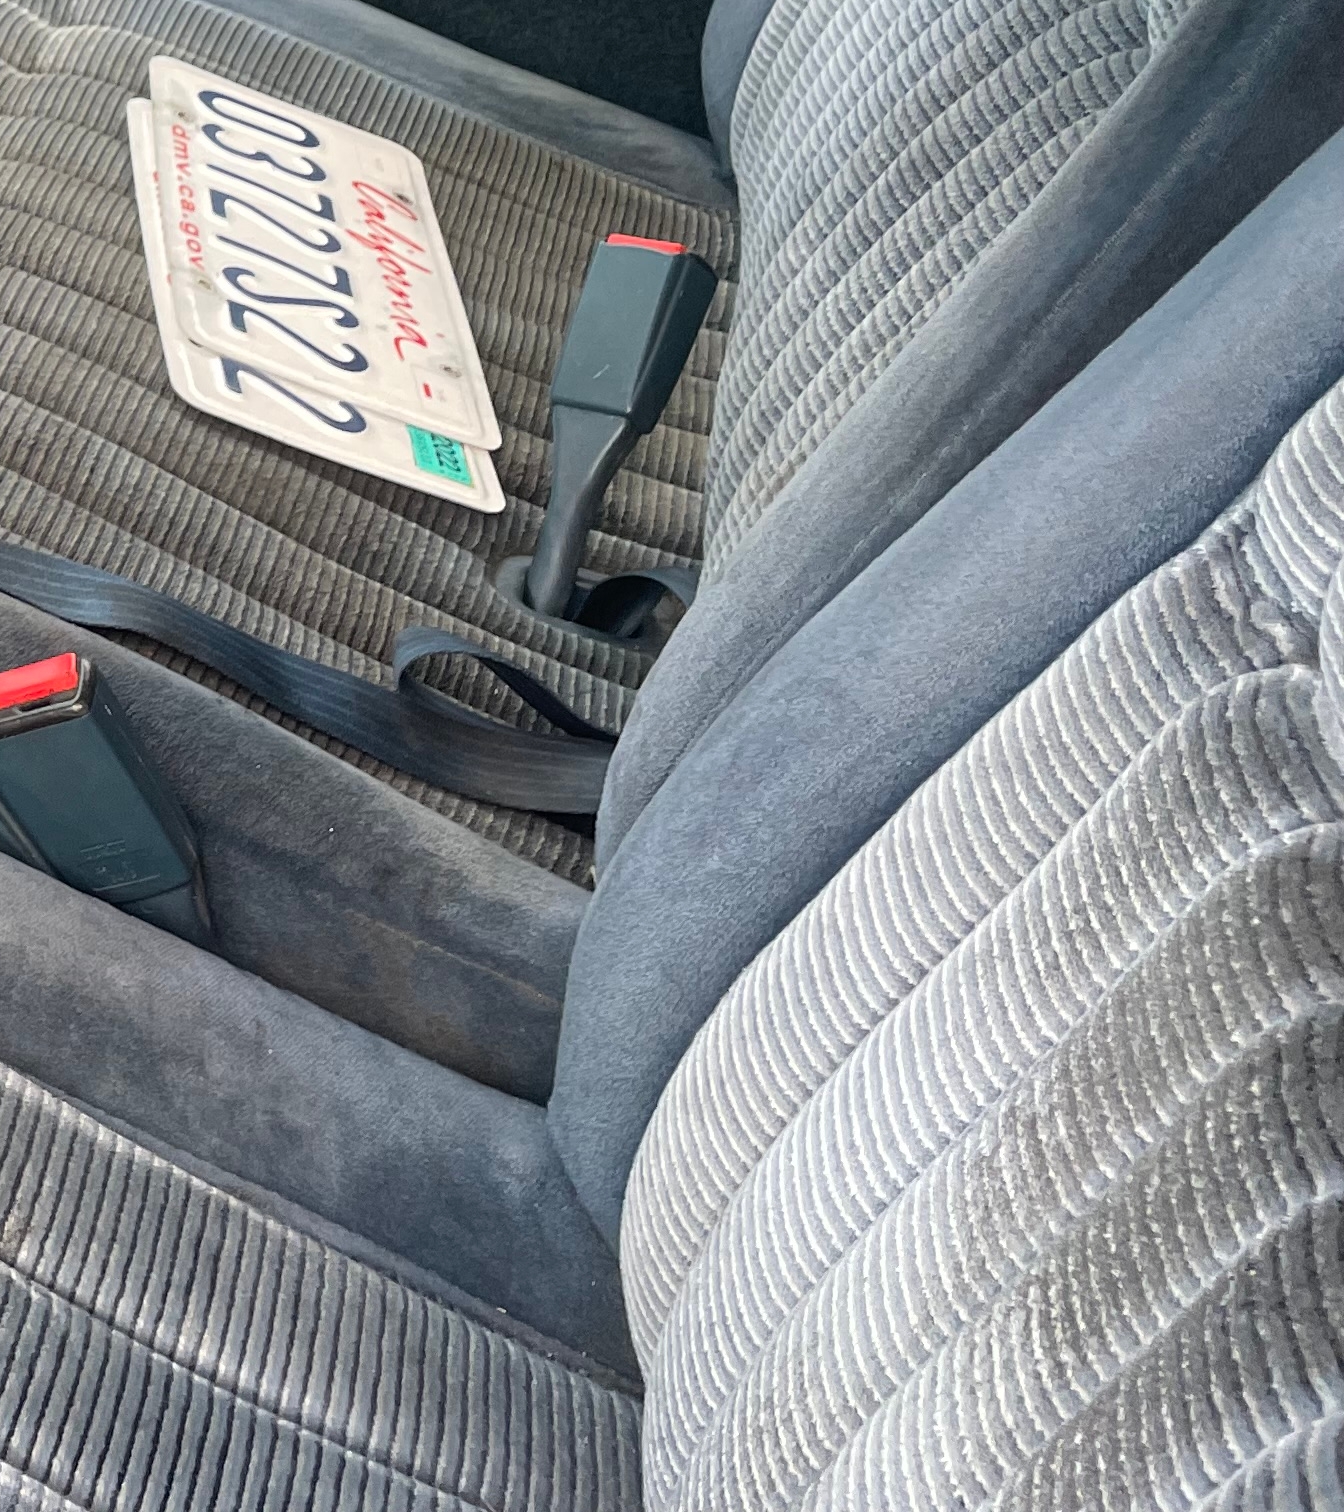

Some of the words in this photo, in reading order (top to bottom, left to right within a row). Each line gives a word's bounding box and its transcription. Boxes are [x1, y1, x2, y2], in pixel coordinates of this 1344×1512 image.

[171, 124, 206, 272] dmv.ca.gov
[197, 89, 370, 374] 03727S2
[345, 180, 446, 362] California
